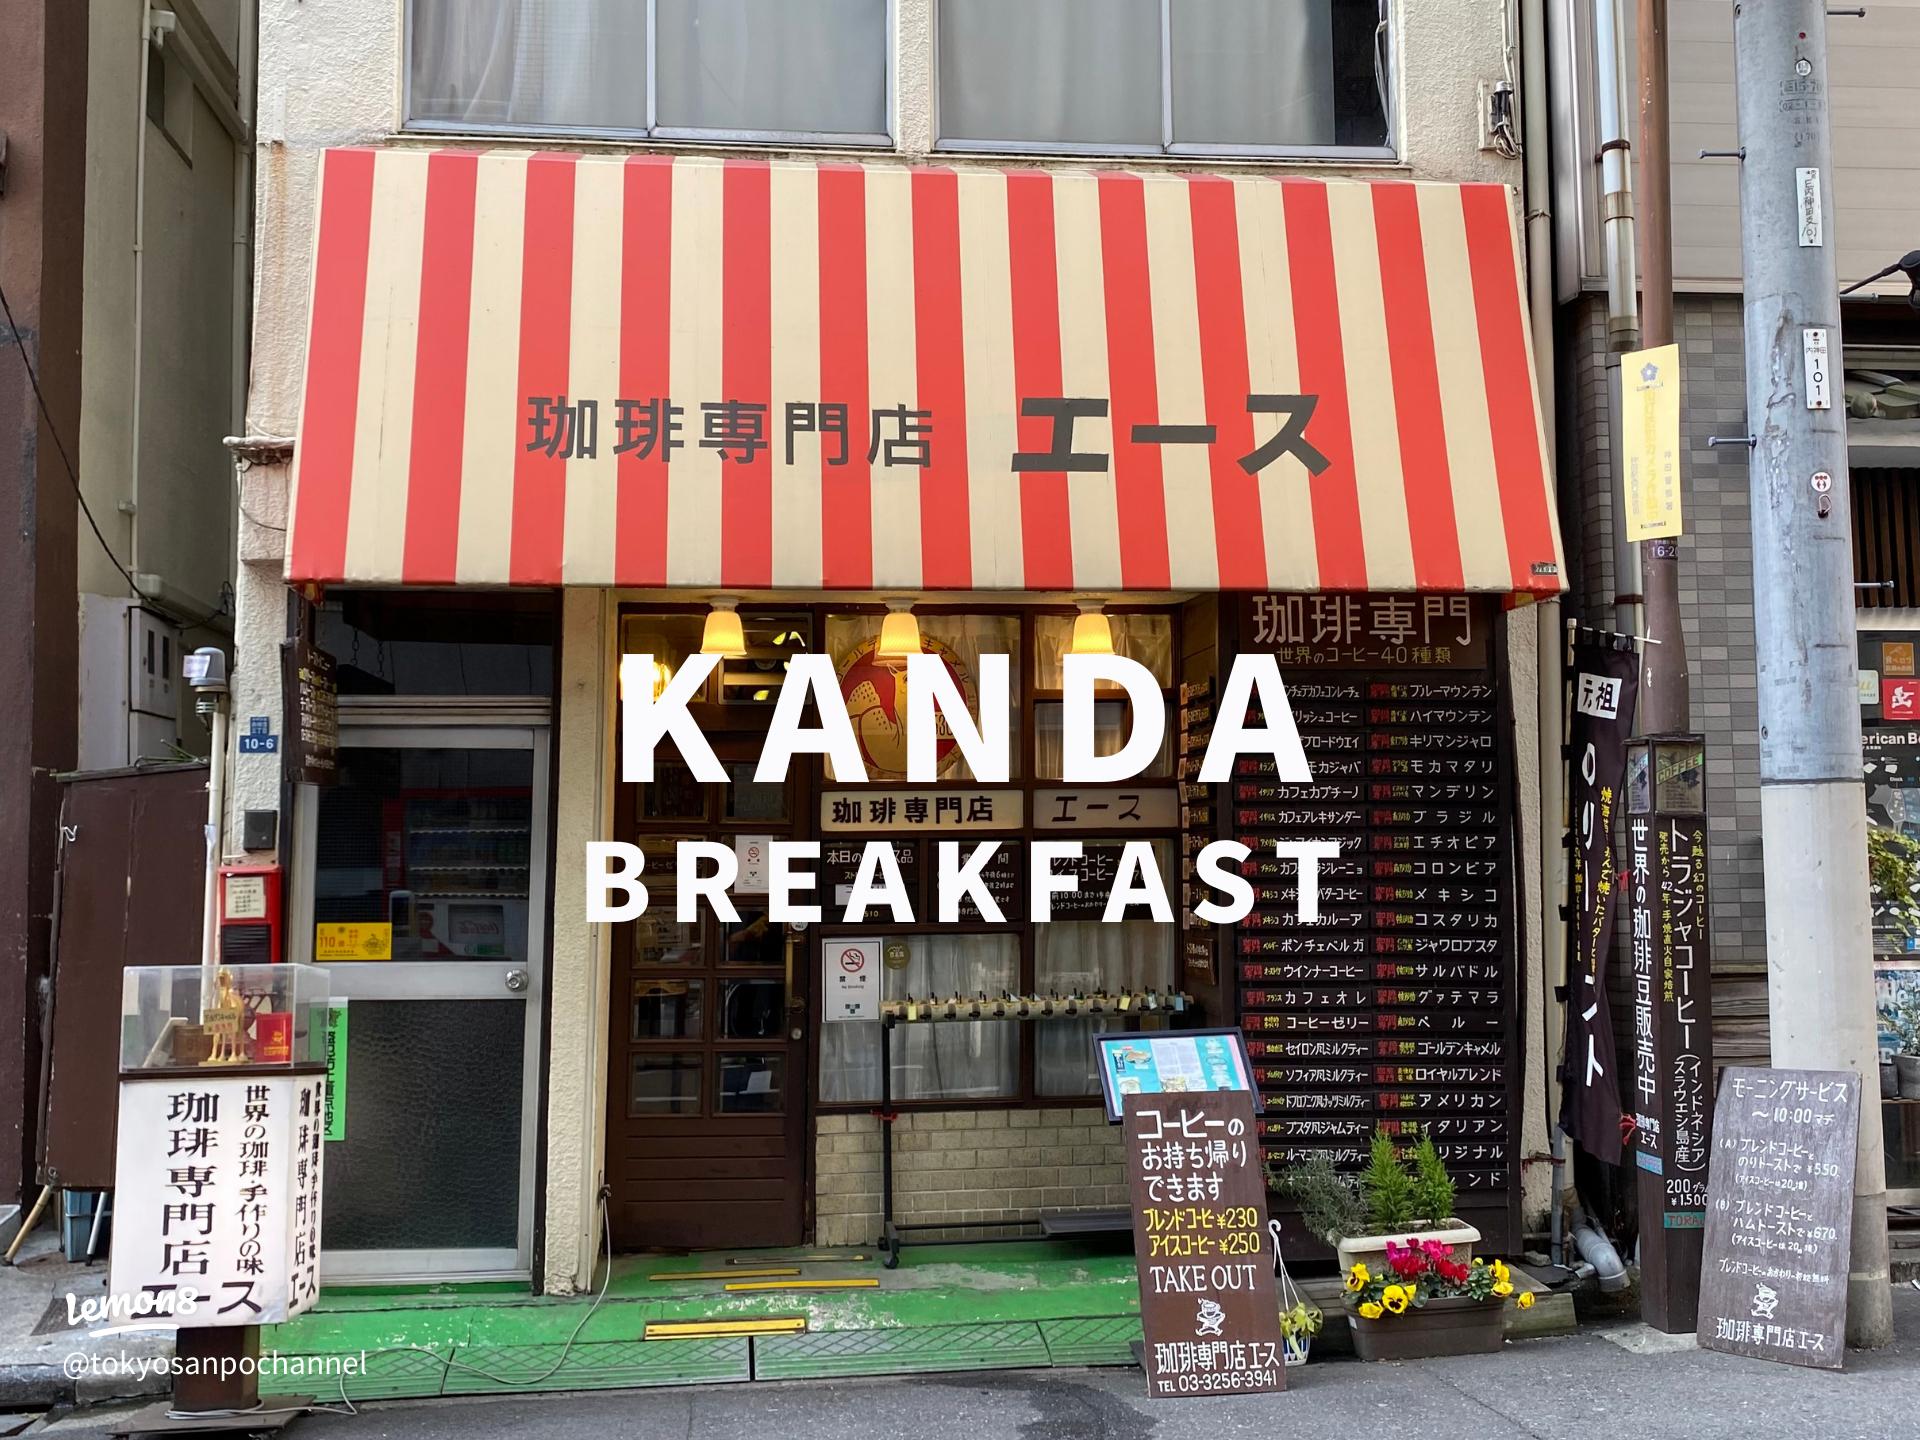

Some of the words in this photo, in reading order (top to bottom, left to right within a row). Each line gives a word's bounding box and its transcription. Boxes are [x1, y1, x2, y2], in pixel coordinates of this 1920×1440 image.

[526, 396, 933, 467] 珈琲専門店
[1011, 394, 1331, 477] エース
[1252, 595, 1471, 645] 珈琲専門
[1410, 684, 1492, 698] ブルーマウンテン
[1292, 710, 1358, 723] リッシュコーヒー
[1410, 710, 1492, 723] ハイマウンテン
[245, 738, 274, 749] 10-6
[1410, 735, 1491, 748] キリマンジャロ
[1411, 760, 1492, 773] モカマタリ
[1278, 786, 1359, 799] カフェカプチーノ
[1412, 785, 1494, 798] マンデリン
[832, 797, 993, 824] 珈琲専門店
[1052, 795, 1141, 822] エース
[1278, 811, 1361, 824] カフェアレキサンダー
[1413, 811, 1495, 824] ブラジル
[1413, 836, 1496, 849] エチオピア
[1413, 862, 1496, 875] コロンビア
[1415, 888, 1496, 902] メキシコ
[1415, 914, 1497, 928] コスタリカ
[1281, 938, 1364, 952] ポンチェベルガ
[1415, 939, 1498, 952] ジャワロブスタ
[1632, 818, 1656, 1105] 世界の珈琲豆販売中
[1284, 964, 1364, 978] ウインナーコーヒー
[1415, 964, 1498, 978] サルバドル
[1285, 991, 1366, 1005] カフェオレ
[1418, 989, 1498, 1004] グァテマラ
[1286, 1016, 1369, 1029] コーヒーゼリー
[1418, 1015, 1498, 1028] ペルー
[1418, 1041, 1501, 1056] ゴールデンキャメル
[1415, 1067, 1501, 1082] ロイヤルブレンド
[1732, 1078, 1848, 1103] モーニングサービス
[1419, 1093, 1501, 1108] アメリカン
[1136, 1109, 1245, 1140] コーヒーの
[1420, 1119, 1502, 1134] イタリアン
[1141, 1140, 1247, 1171] お持ち帰り
[1438, 1145, 1503, 1160] リジナル
[1738, 1156, 1802, 1173] のりトーストで
[160, 1092, 220, 1276] 珈琲専門店
[1143, 1171, 1224, 1202] できます
[1666, 1179, 1691, 1194] 200
[1143, 1207, 1215, 1232] ブレンドコーヒー
[1216, 1206, 1258, 1230] ¥230
[1732, 1216, 1806, 1237] ハムトーストで
[1149, 1234, 1216, 1257] アイスコーヒー
[1219, 1231, 1261, 1255] ¥250
[1150, 1265, 1208, 1293] TAKE
[1211, 1264, 1257, 1291] OUT
[289, 1265, 316, 1308] エース
[1715, 1316, 1795, 1349] 珈琲専門店
[1798, 1329, 1825, 1351] エース
[1154, 1339, 1247, 1375] 珈琲専門店
[1249, 1342, 1281, 1370] エース
[1158, 1380, 1176, 1393] TEL
[1178, 1369, 1278, 1393] 03-3256-3941
